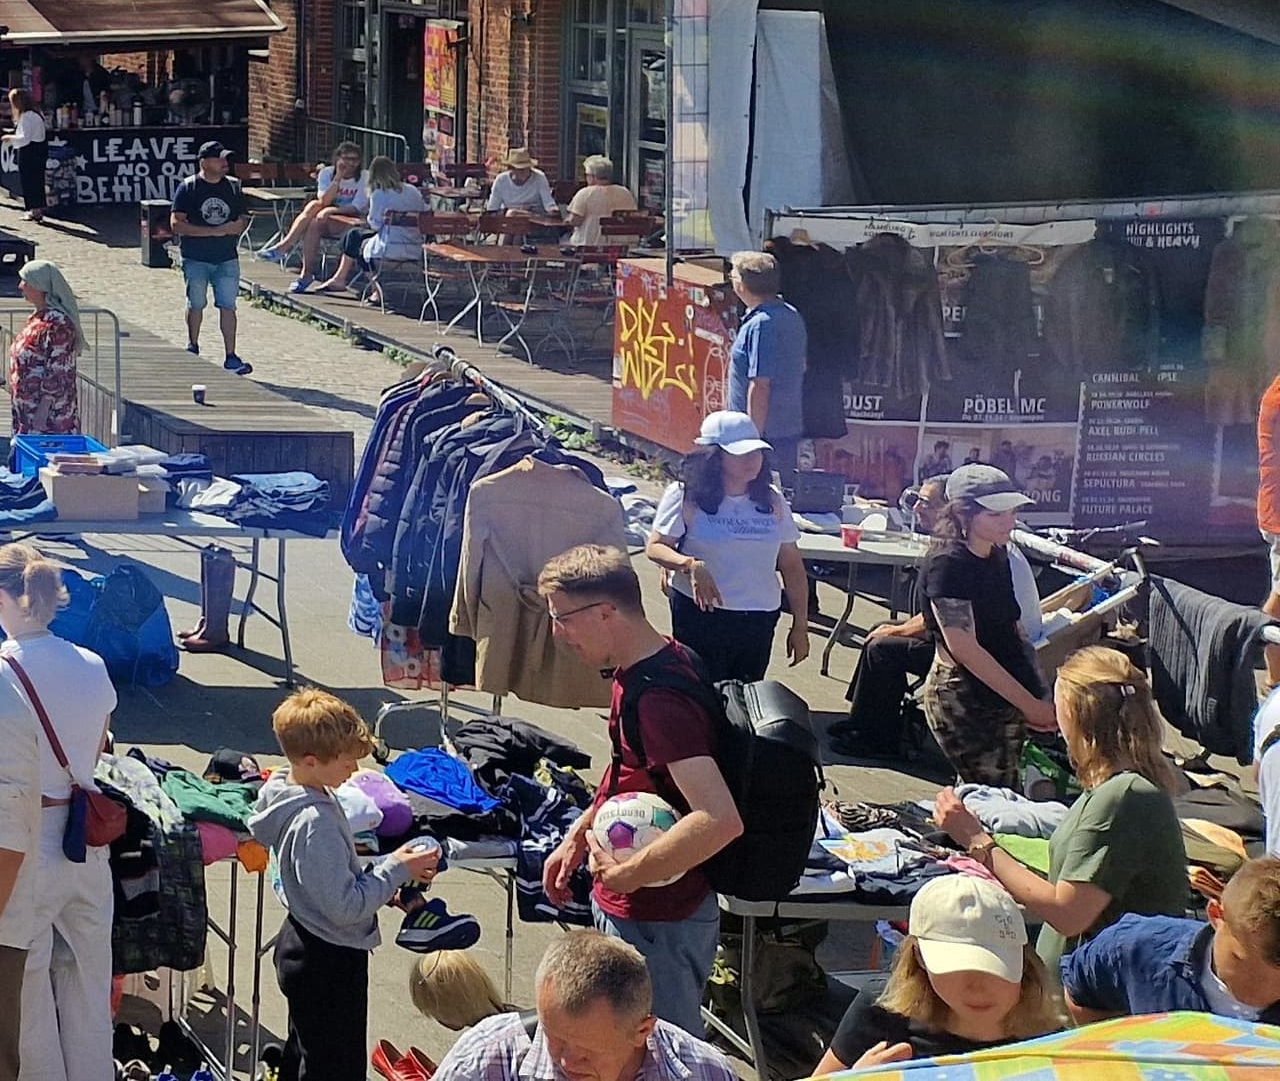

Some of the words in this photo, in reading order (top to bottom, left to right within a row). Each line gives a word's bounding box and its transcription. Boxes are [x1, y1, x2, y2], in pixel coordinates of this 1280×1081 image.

[93, 137, 197, 163] LEAVE
[117, 162, 150, 176] NO
[161, 161, 196, 177] ON
[1126, 222, 1195, 236] HIGHLIGHTS
[1145, 236, 1154, 248] &
[1092, 372, 1140, 384] CANNIBAL
[963, 394, 1015, 414] PÖBEL
[1020, 398, 1047, 414] MC
[1088, 425, 1111, 437] AXEL
[1086, 451, 1126, 463] RUSSIAN
[1128, 451, 1166, 462] CIRCLES
[1083, 478, 1136, 489] SEPULTURA
[1081, 505, 1116, 515] FUTURE
[1119, 505, 1153, 515] PALACE
